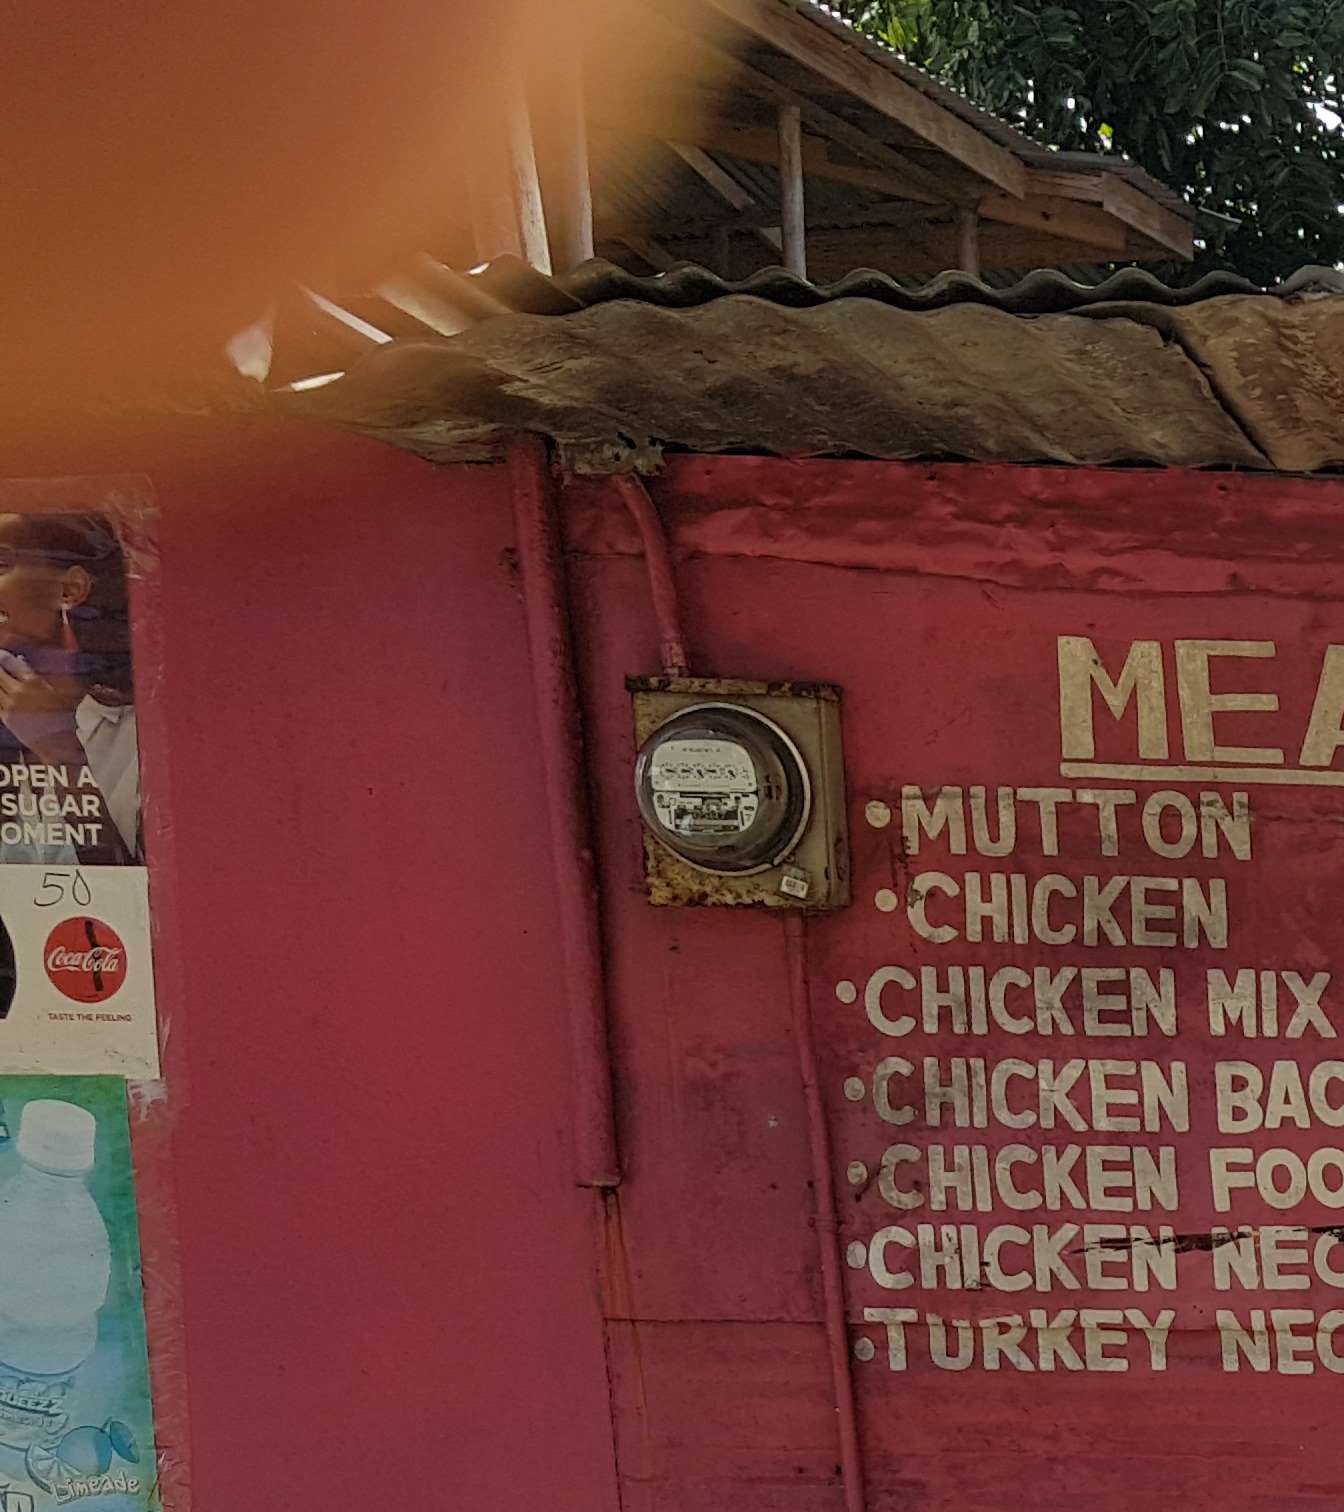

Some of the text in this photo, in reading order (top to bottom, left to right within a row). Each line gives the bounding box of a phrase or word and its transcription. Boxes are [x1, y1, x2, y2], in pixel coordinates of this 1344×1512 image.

[2, 793, 101, 817] SUGAR
[77, 765, 98, 788] A
[901, 785, 1252, 860] MUTTON
[908, 872, 1227, 948] CHICKEN
[48, 1012, 132, 1022] TASTE THE FEELING
[865, 967, 1336, 1038] CHICKEN MIX
[873, 1057, 1189, 1131] CHICKEN
[879, 1144, 1178, 1212] CHICKEN
[868, 1224, 1176, 1291] CHICKEN
[864, 1308, 1175, 1371] TURKEY
[51, 1472, 140, 1505] Limeade
